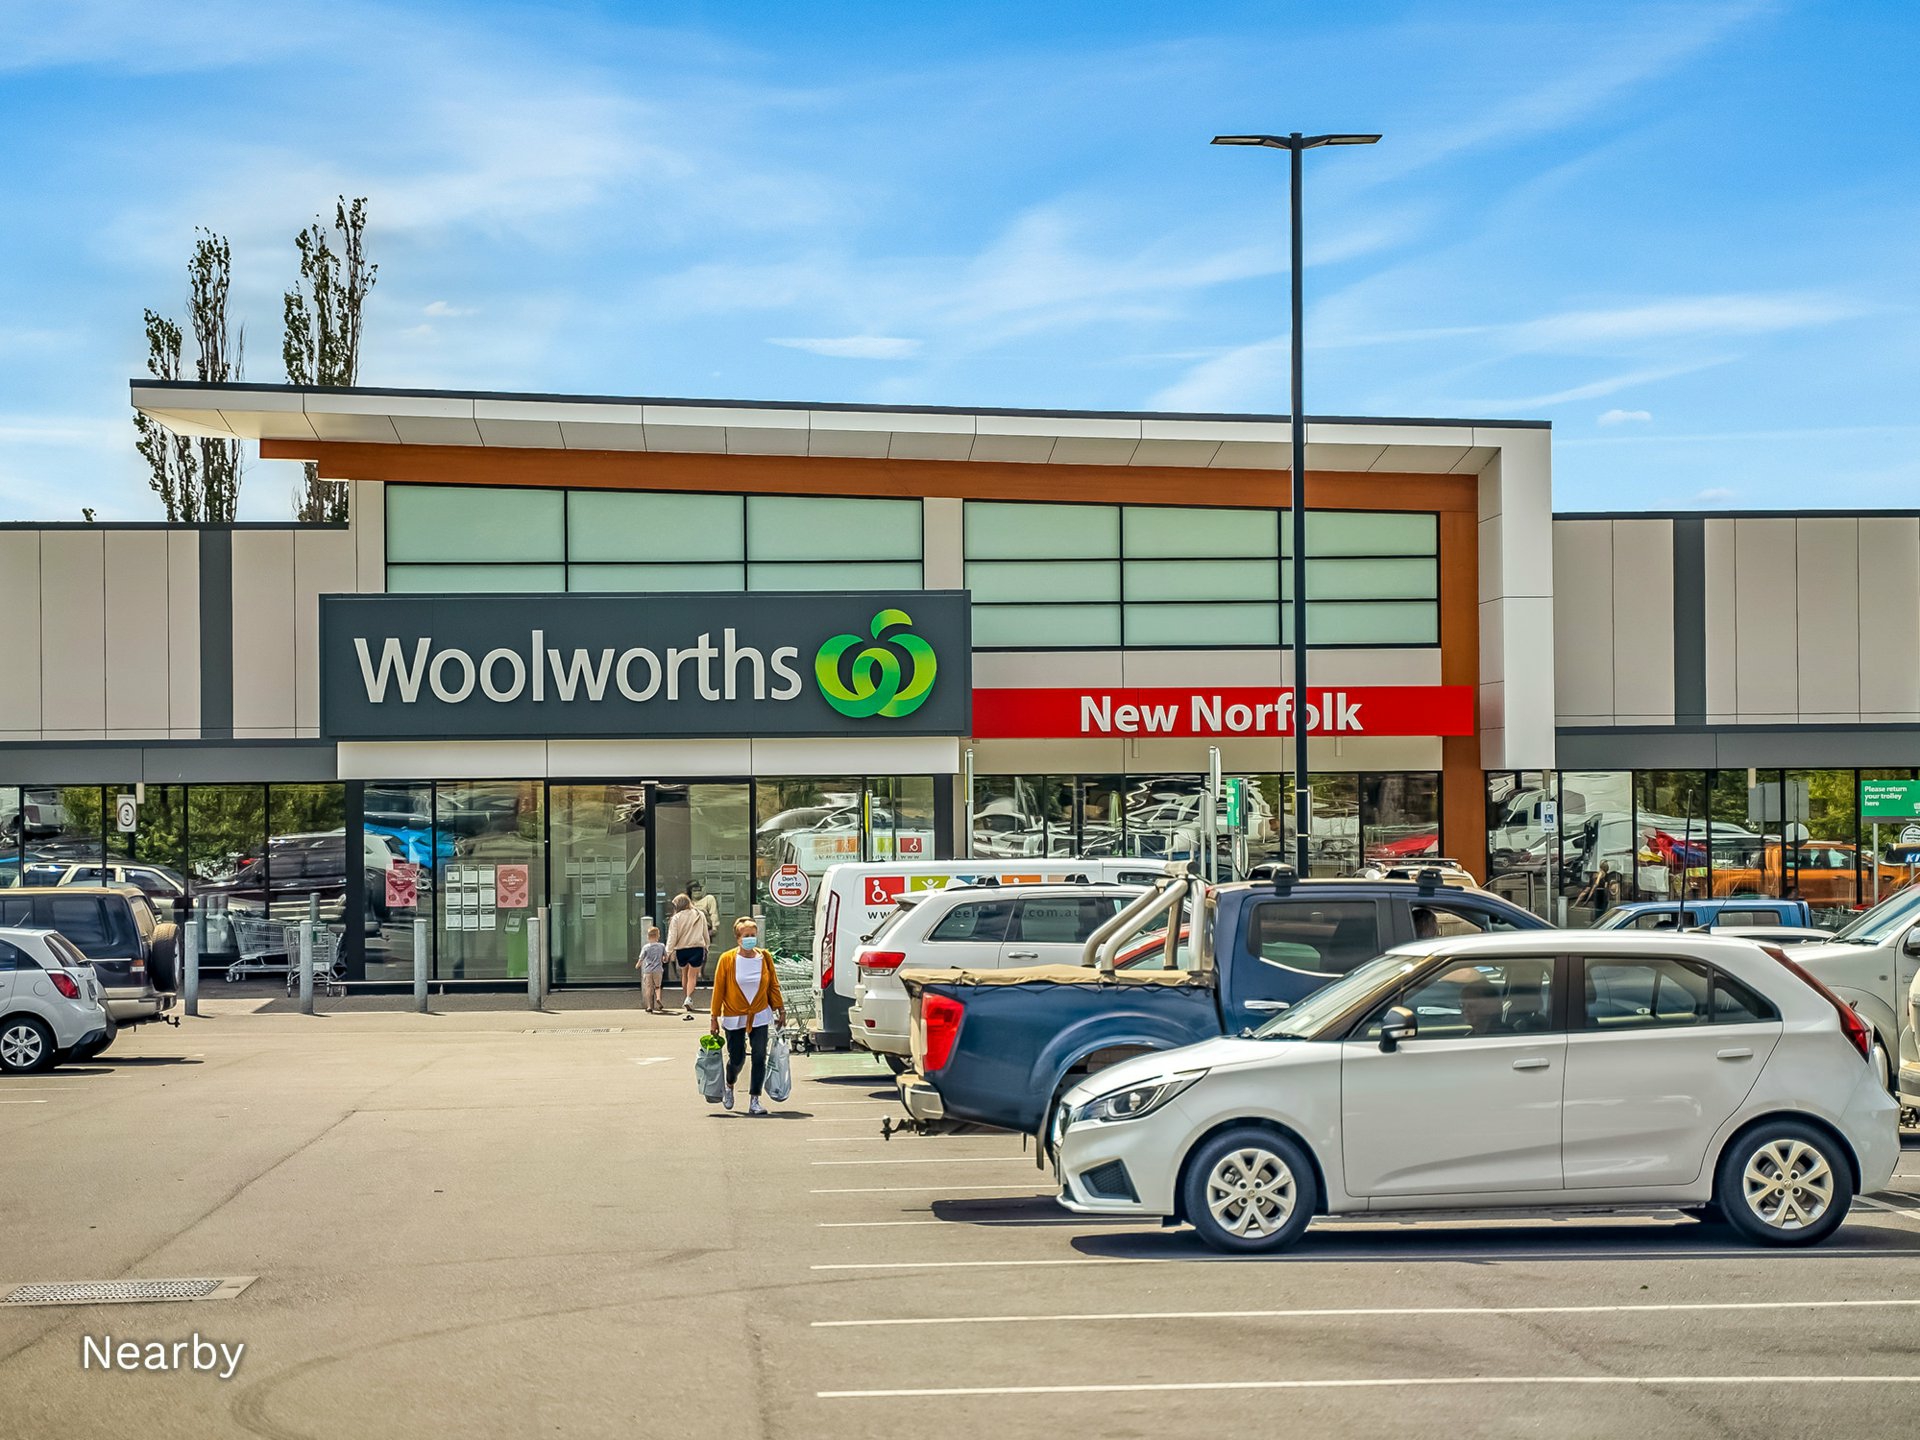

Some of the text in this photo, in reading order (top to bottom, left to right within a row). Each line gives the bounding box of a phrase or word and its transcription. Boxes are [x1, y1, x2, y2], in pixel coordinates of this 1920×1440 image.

[353, 627, 803, 704] Woolworths
[1080, 692, 1364, 732] New Norfolk
[1880, 792, 1902, 800] trolley
